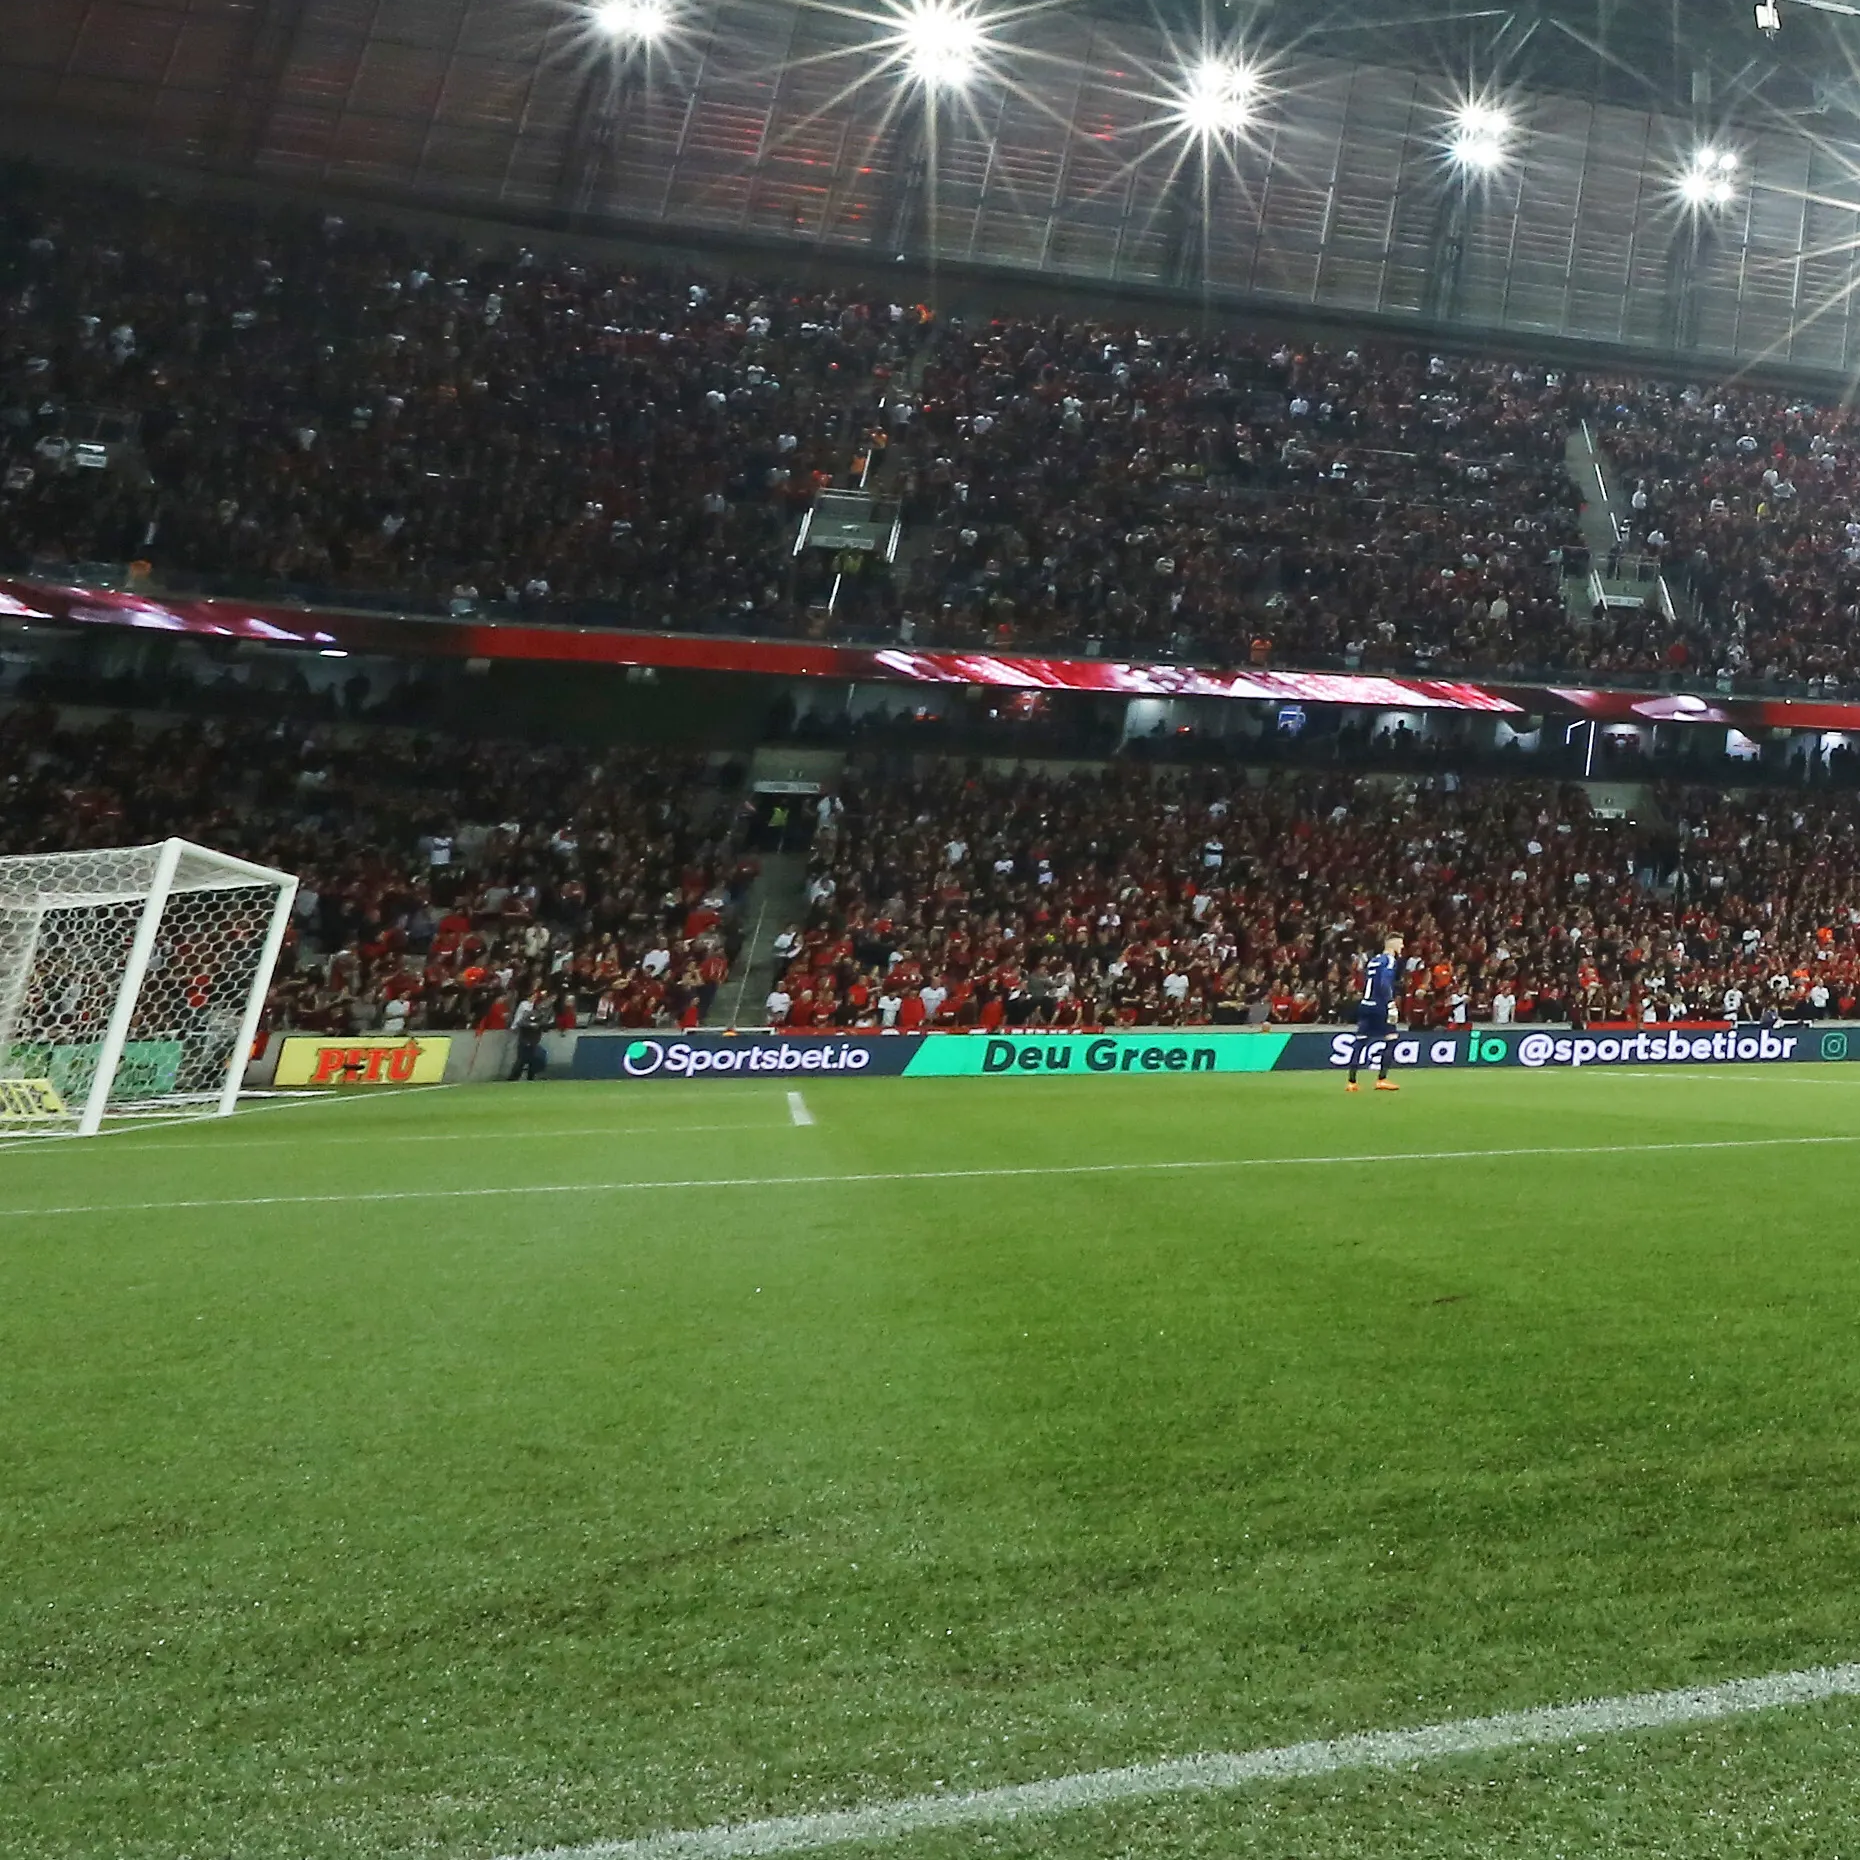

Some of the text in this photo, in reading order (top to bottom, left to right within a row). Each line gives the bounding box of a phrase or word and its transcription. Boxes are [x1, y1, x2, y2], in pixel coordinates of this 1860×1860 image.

[663, 1043, 870, 1077] Sportsbet.io
[982, 1038, 1217, 1073] Deu Green
[1430, 1039, 1457, 1064] a
[1468, 1030, 1507, 1063] io
[1518, 1029, 1798, 1067] @sportsbetiobr
